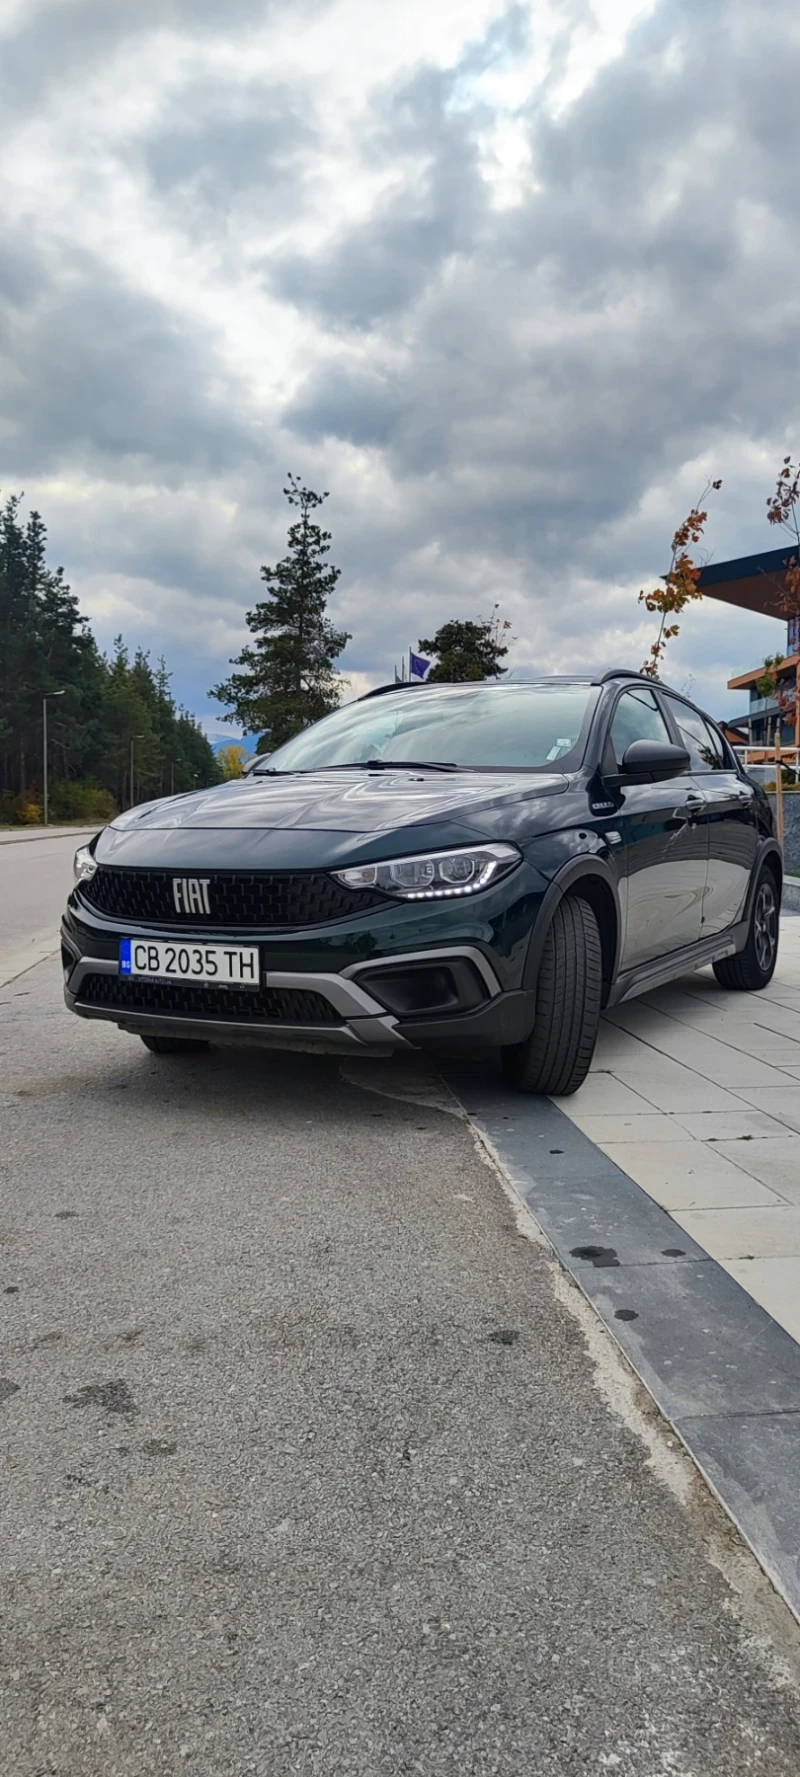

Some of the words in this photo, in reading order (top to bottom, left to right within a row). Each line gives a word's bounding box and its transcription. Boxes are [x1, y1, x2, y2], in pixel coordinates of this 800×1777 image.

[172, 878, 210, 914] FIAT
[121, 960, 131, 969] BG
[134, 945, 160, 972] CB
[165, 947, 218, 976] 2035
[223, 951, 254, 979] TH
